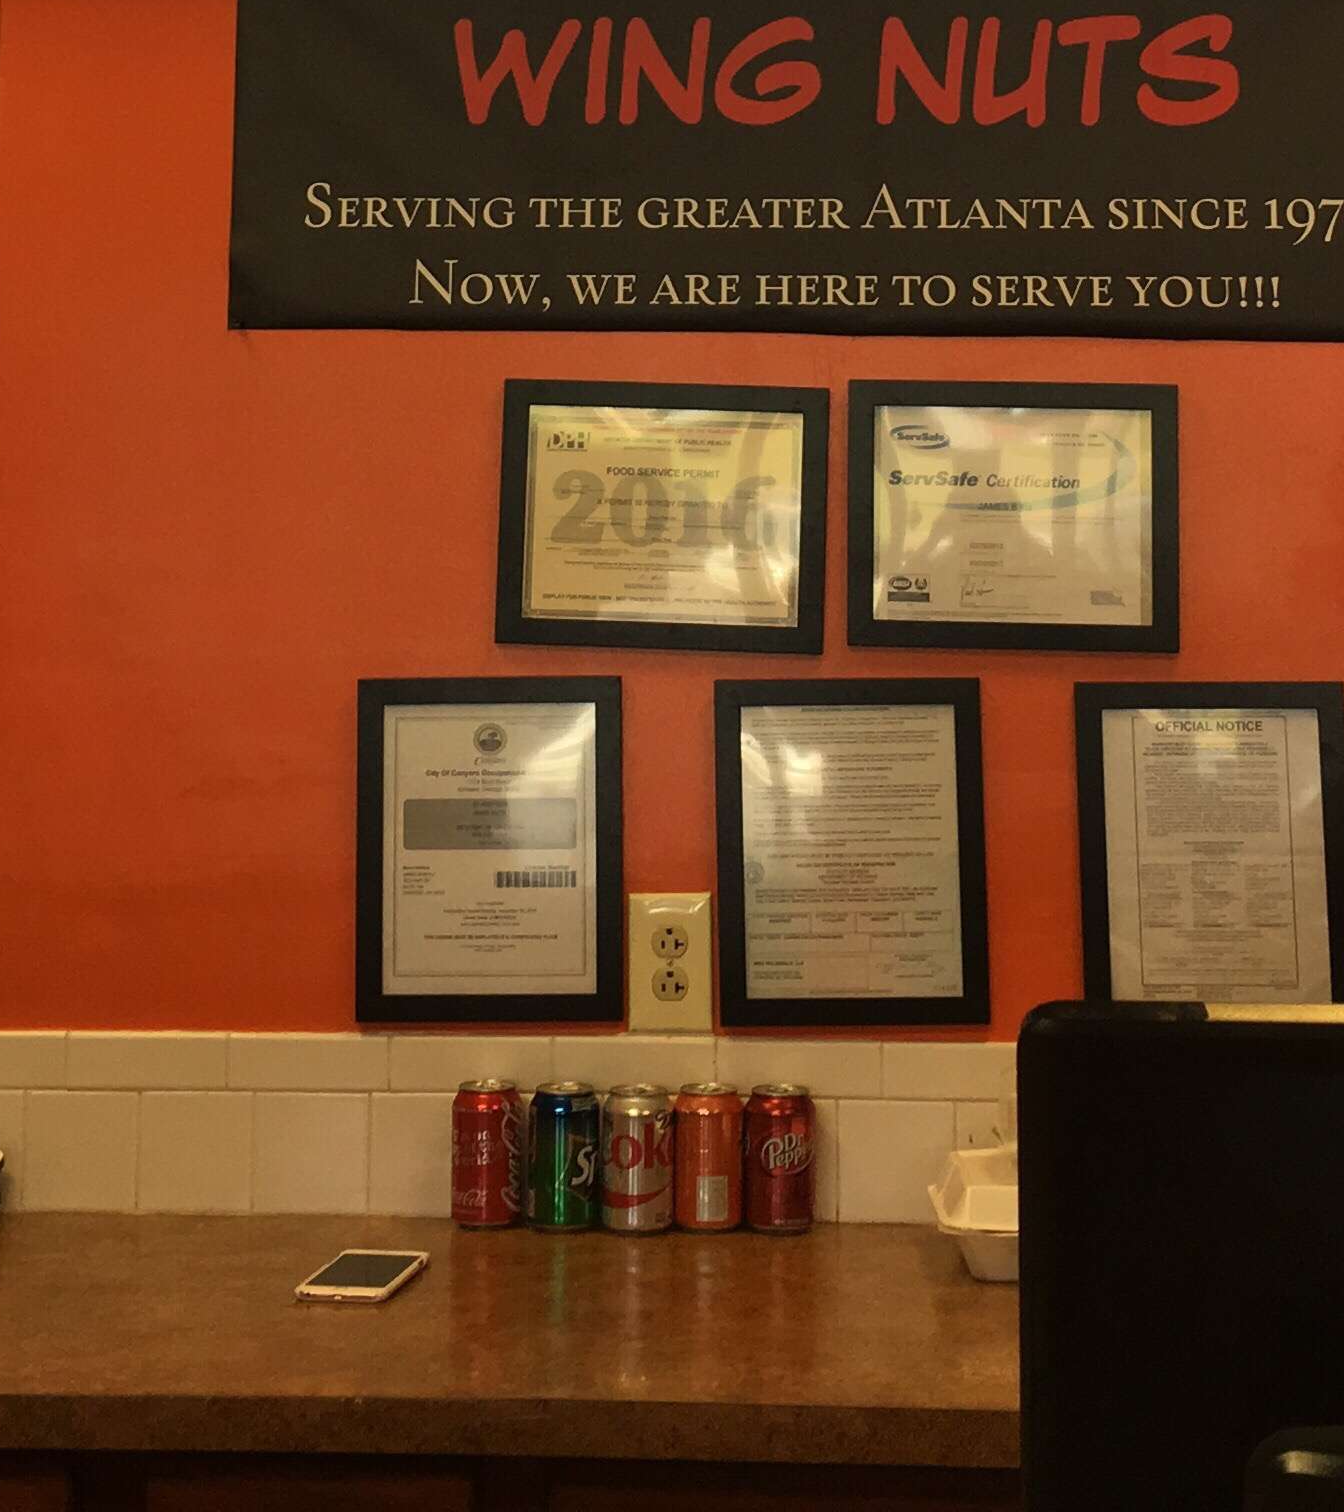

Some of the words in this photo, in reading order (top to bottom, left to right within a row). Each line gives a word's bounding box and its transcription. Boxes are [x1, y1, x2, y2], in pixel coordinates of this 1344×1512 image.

[454, 17, 821, 126] WING
[877, 14, 1240, 128] NUTS
[888, 470, 978, 487] ServSafe
[986, 473, 1080, 490] Certification
[549, 469, 778, 552] 2016
[1155, 720, 1212, 732] OFFICIAL
[1216, 719, 1263, 732] NOTICE
